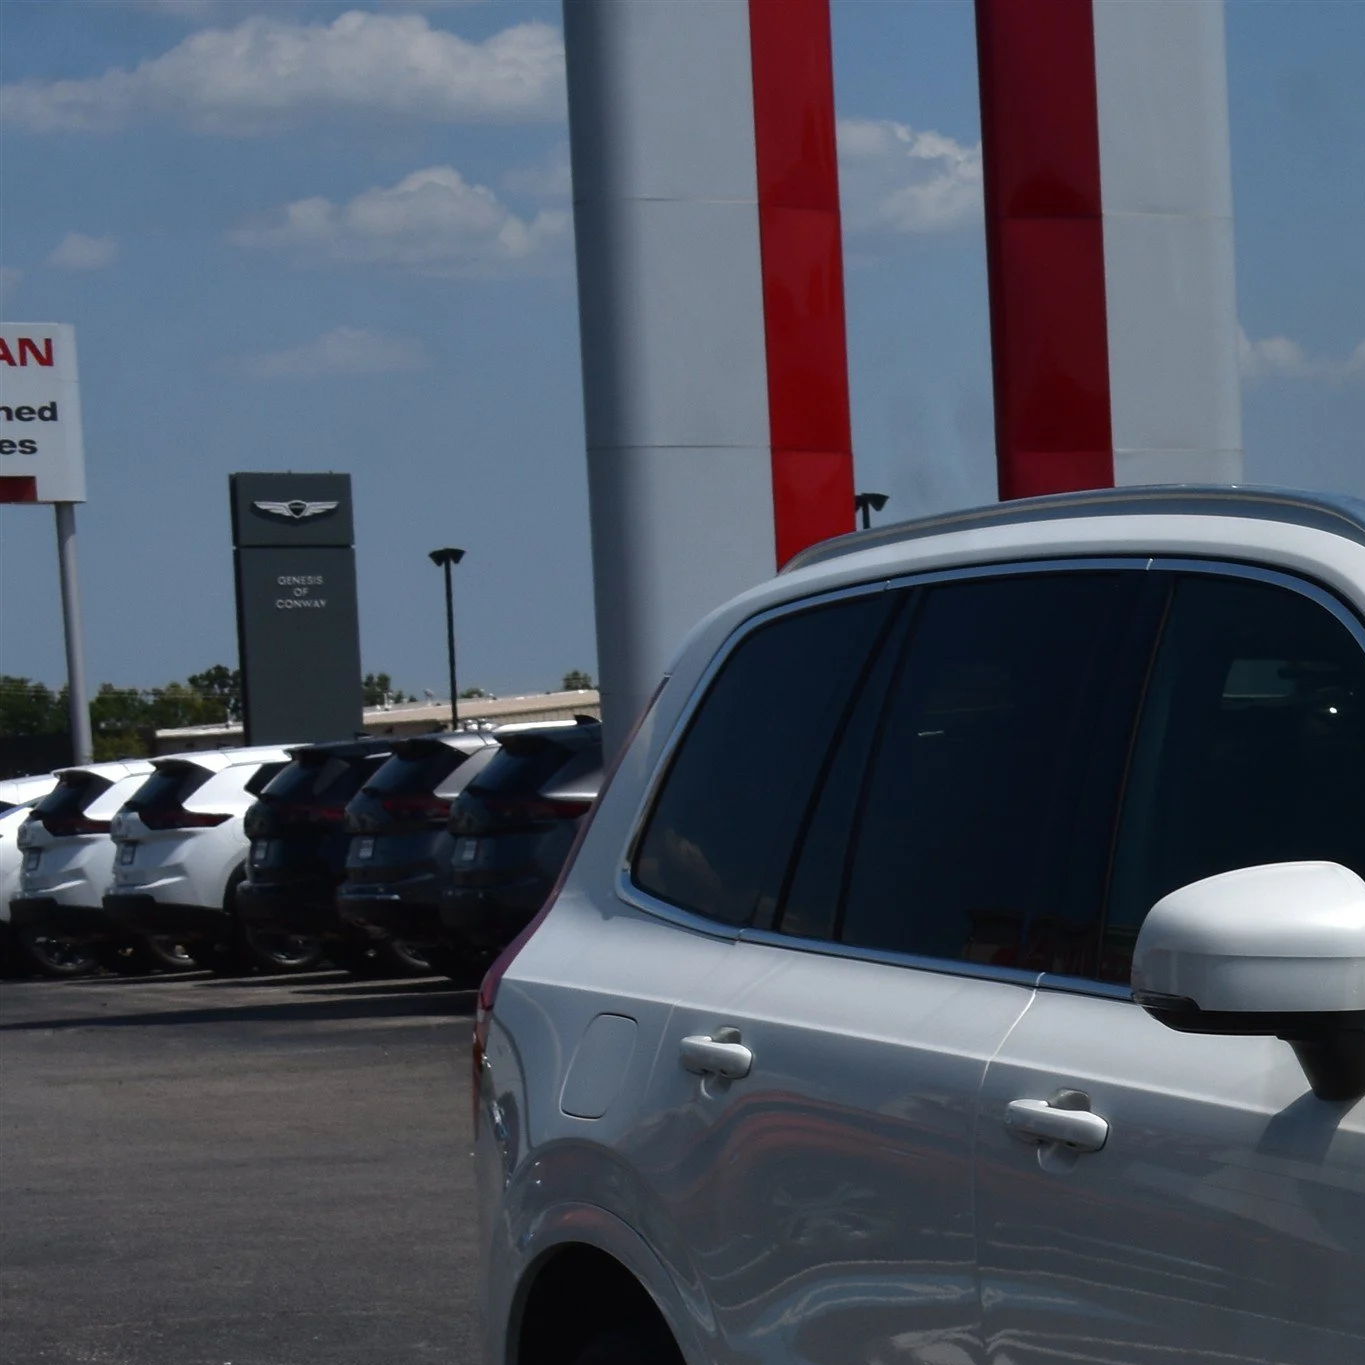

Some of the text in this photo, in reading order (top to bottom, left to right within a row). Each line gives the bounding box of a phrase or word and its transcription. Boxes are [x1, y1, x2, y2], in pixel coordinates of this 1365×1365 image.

[0, 438, 38, 455] es
[277, 575, 324, 586] GENESIS
[293, 587, 309, 597] OF
[275, 599, 327, 609] CONWAY
